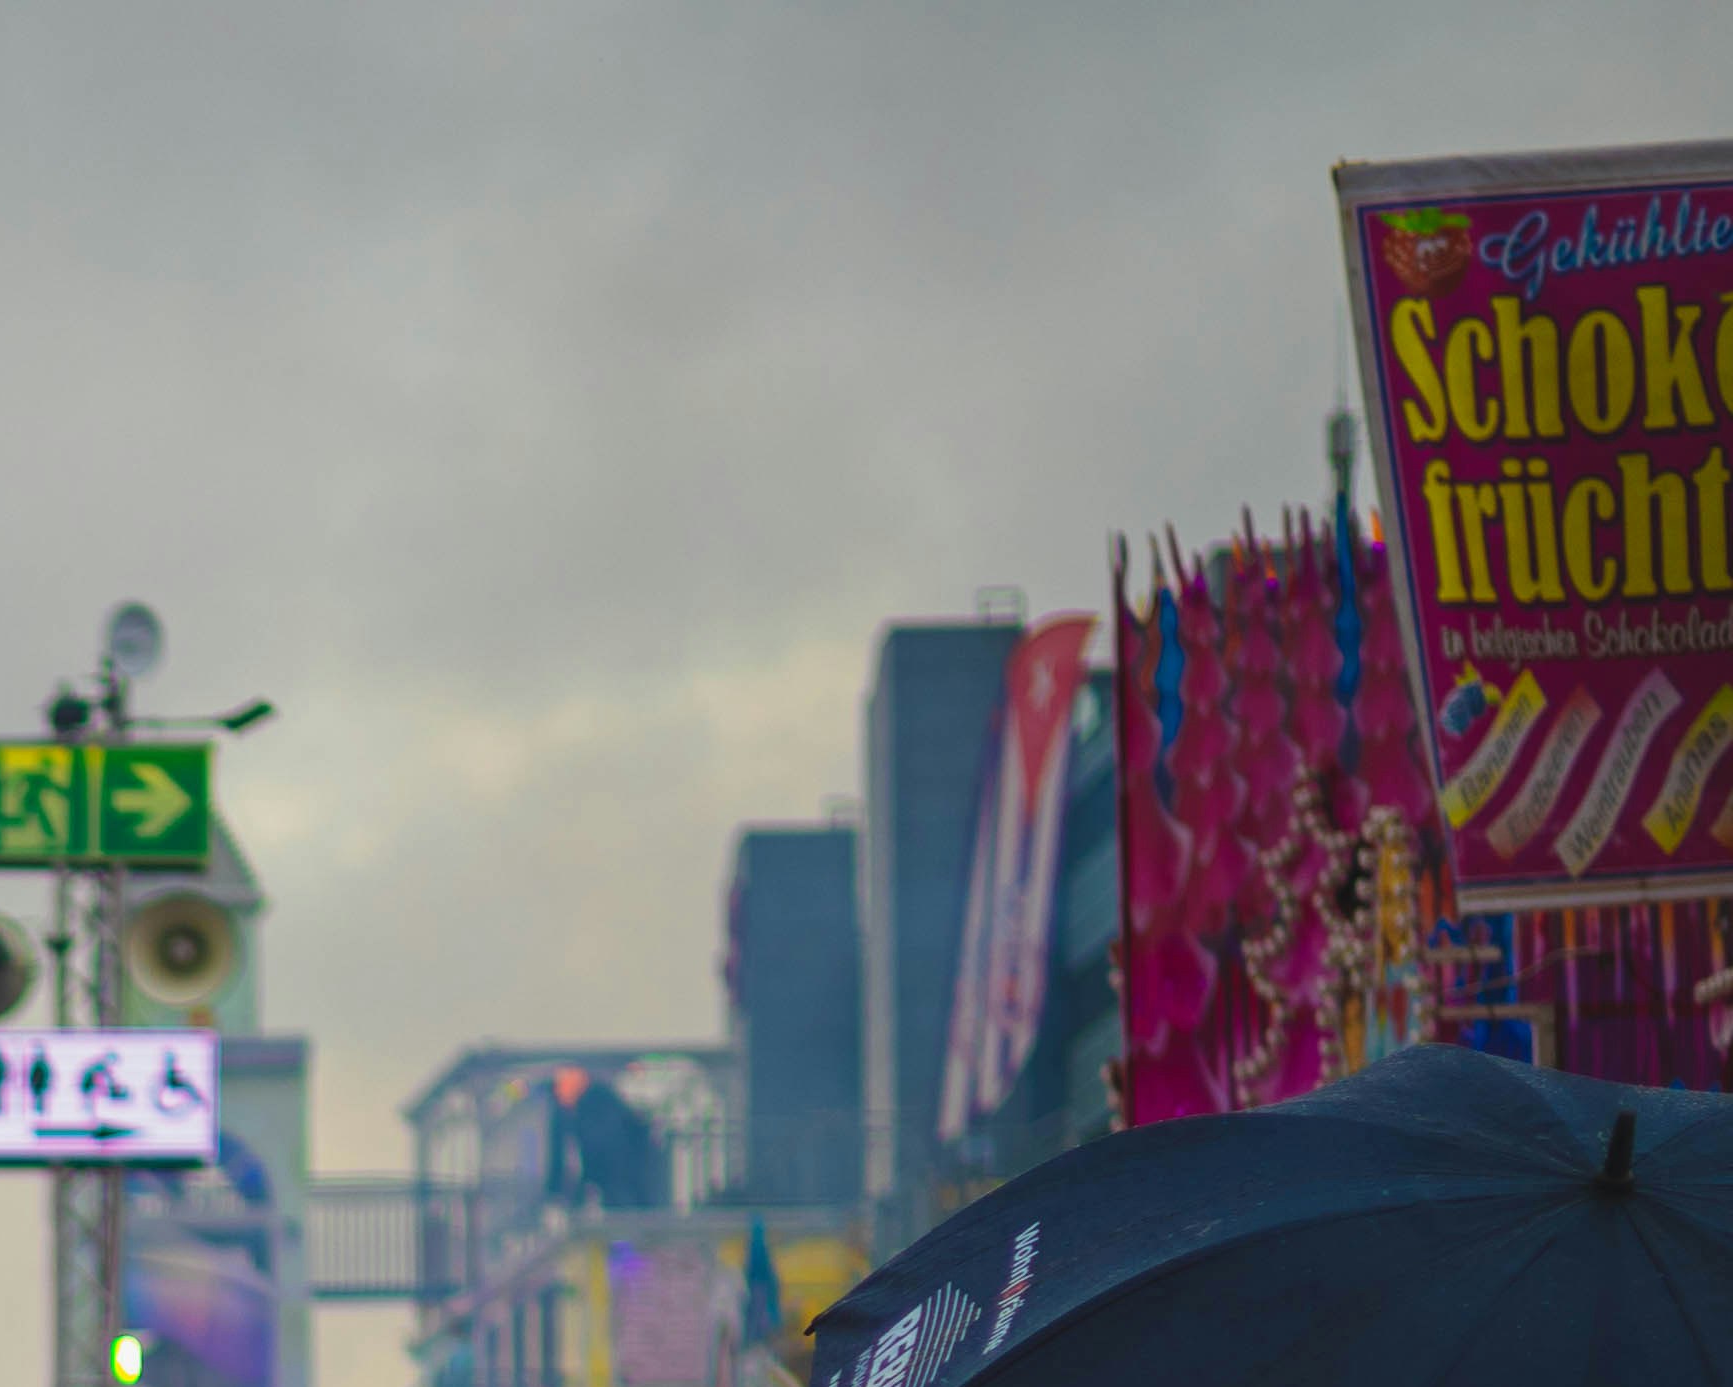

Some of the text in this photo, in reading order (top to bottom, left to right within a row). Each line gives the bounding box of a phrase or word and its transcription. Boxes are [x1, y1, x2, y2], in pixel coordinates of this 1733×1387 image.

[1480, 193, 1733, 300] Gekühlte
[1441, 625, 1465, 660] in
[1469, 612, 1579, 669] belgischer
[1459, 692, 1533, 809] Bananen
[1570, 689, 1663, 860] Weintrauben
[1663, 711, 1730, 833] Ananas
